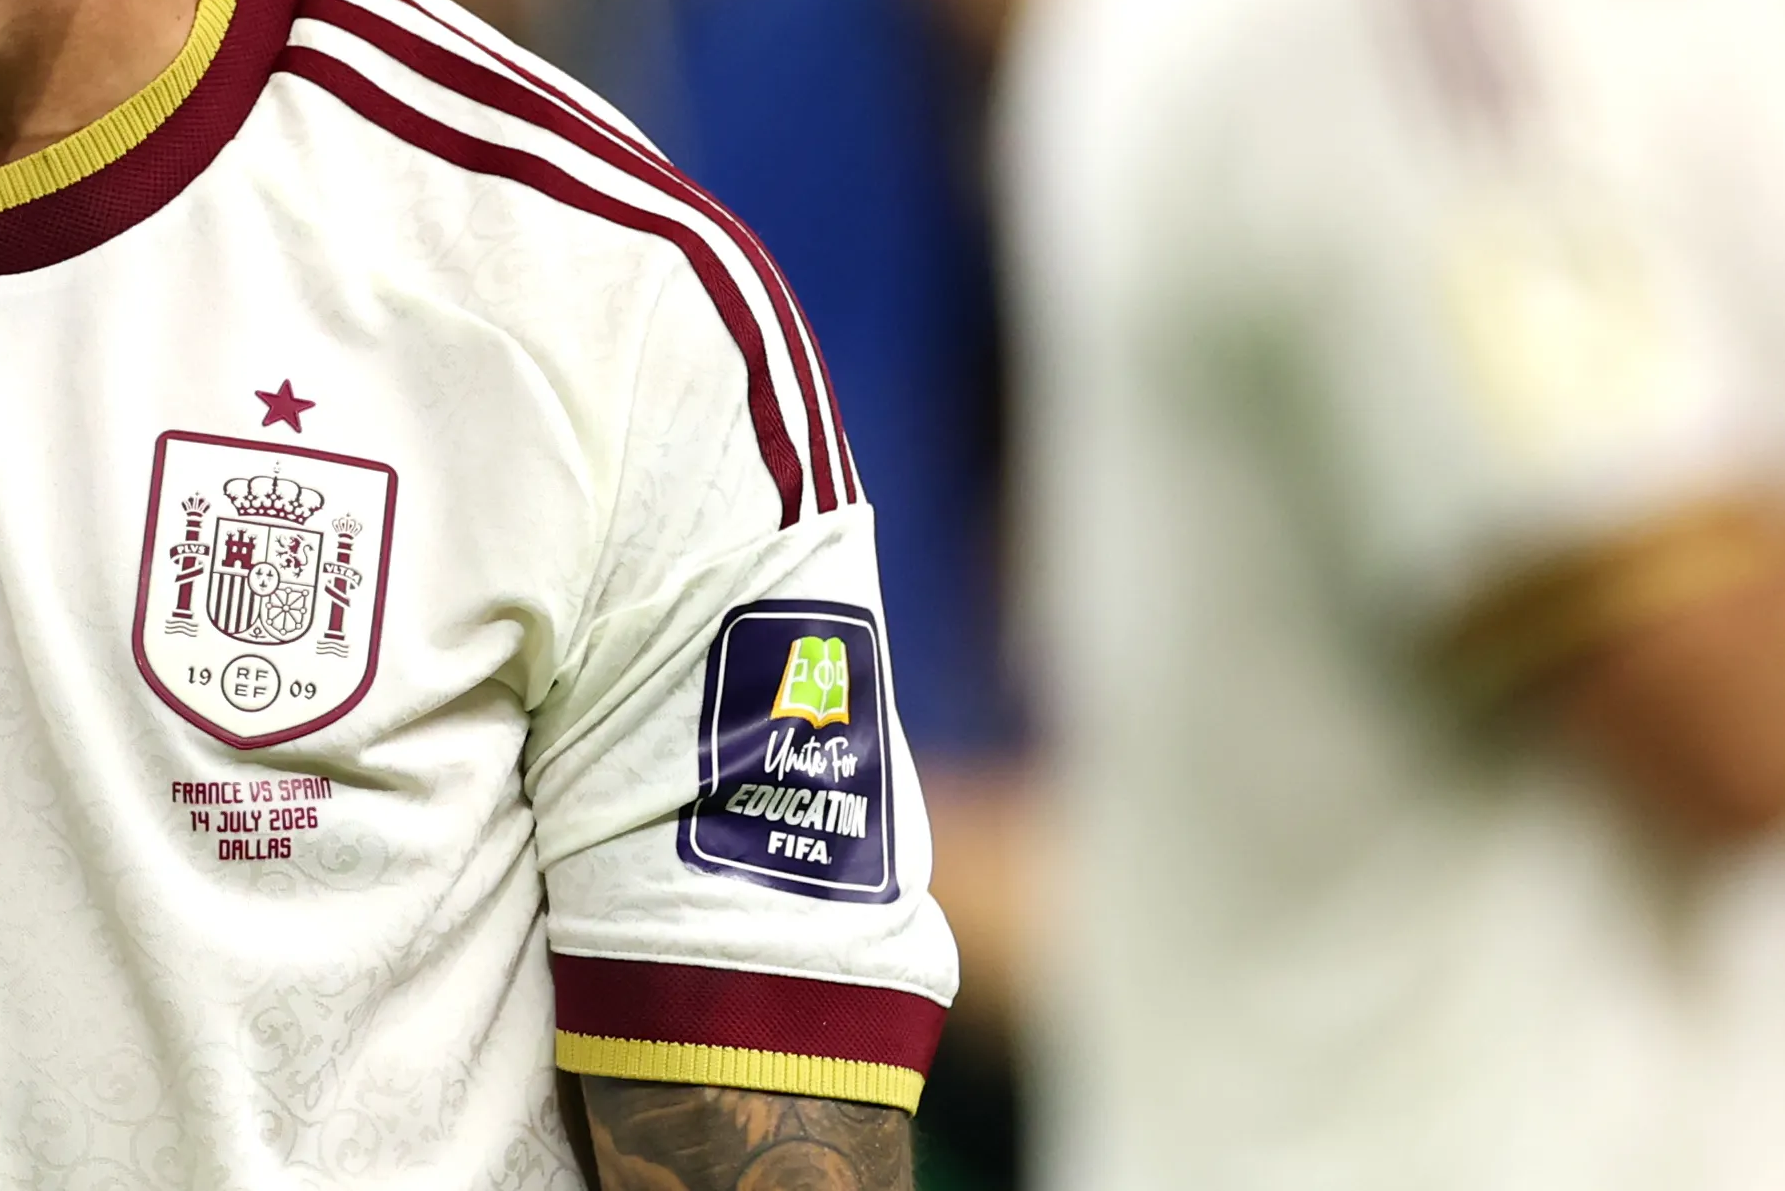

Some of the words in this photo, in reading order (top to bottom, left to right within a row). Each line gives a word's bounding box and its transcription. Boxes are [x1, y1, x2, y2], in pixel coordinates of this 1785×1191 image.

[177, 544, 206, 555] PLVS
[325, 563, 360, 583] VLTRA
[188, 666, 212, 686] 19
[289, 679, 317, 700] 09
[764, 727, 827, 781] Unite
[824, 736, 858, 783] For
[172, 781, 243, 805] FRANCE
[249, 780, 274, 803] VS
[278, 776, 333, 801] SPAIN
[190, 810, 210, 832] 14
[216, 810, 262, 833] JULY
[269, 807, 319, 831] 2026
[725, 783, 868, 839] EDUCATION
[219, 837, 292, 861] DALLAS
[767, 830, 829, 865] FIFA
